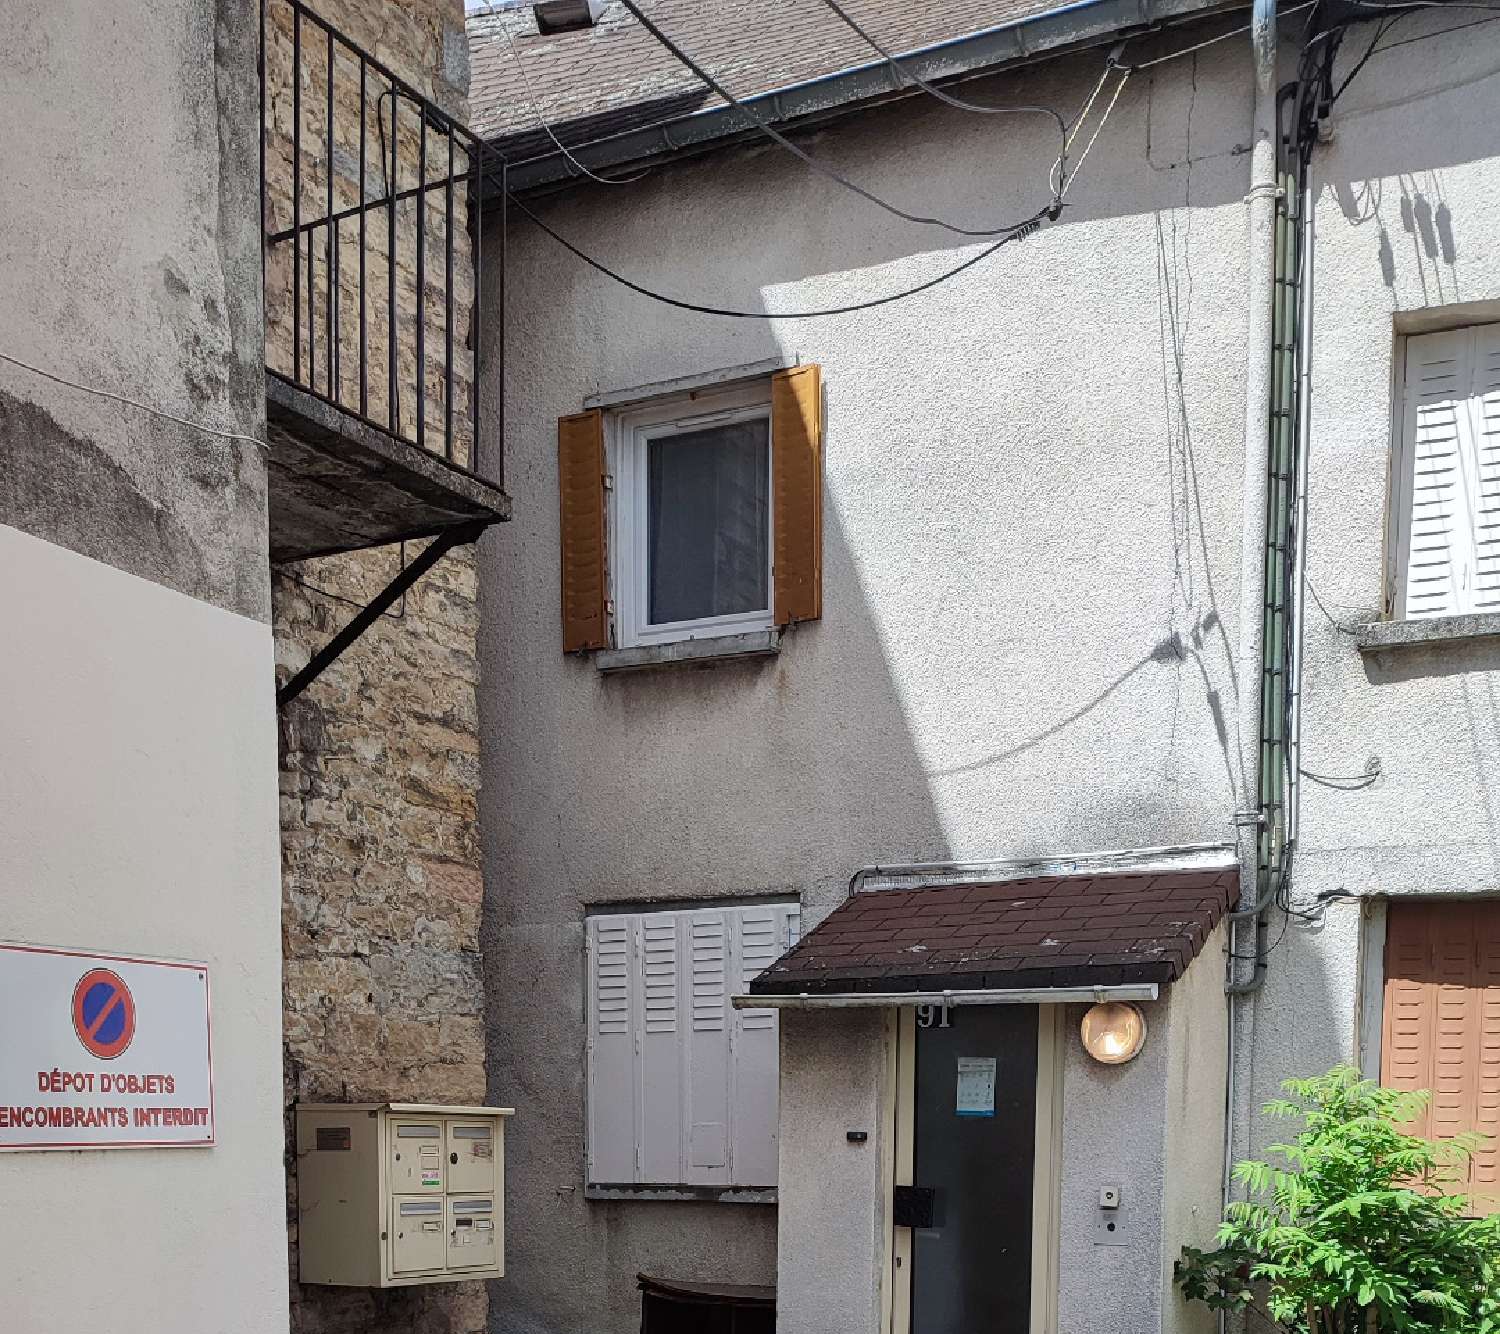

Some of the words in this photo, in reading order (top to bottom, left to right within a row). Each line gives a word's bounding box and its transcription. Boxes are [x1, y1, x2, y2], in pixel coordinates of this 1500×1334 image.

[917, 1004, 951, 1028] 91
[37, 1067, 95, 1093] DÉPOT
[100, 1073, 175, 1094] D'OBJETS
[0, 1106, 129, 1128] ENCOMBRANTS
[133, 1107, 209, 1126] INTERDIT
